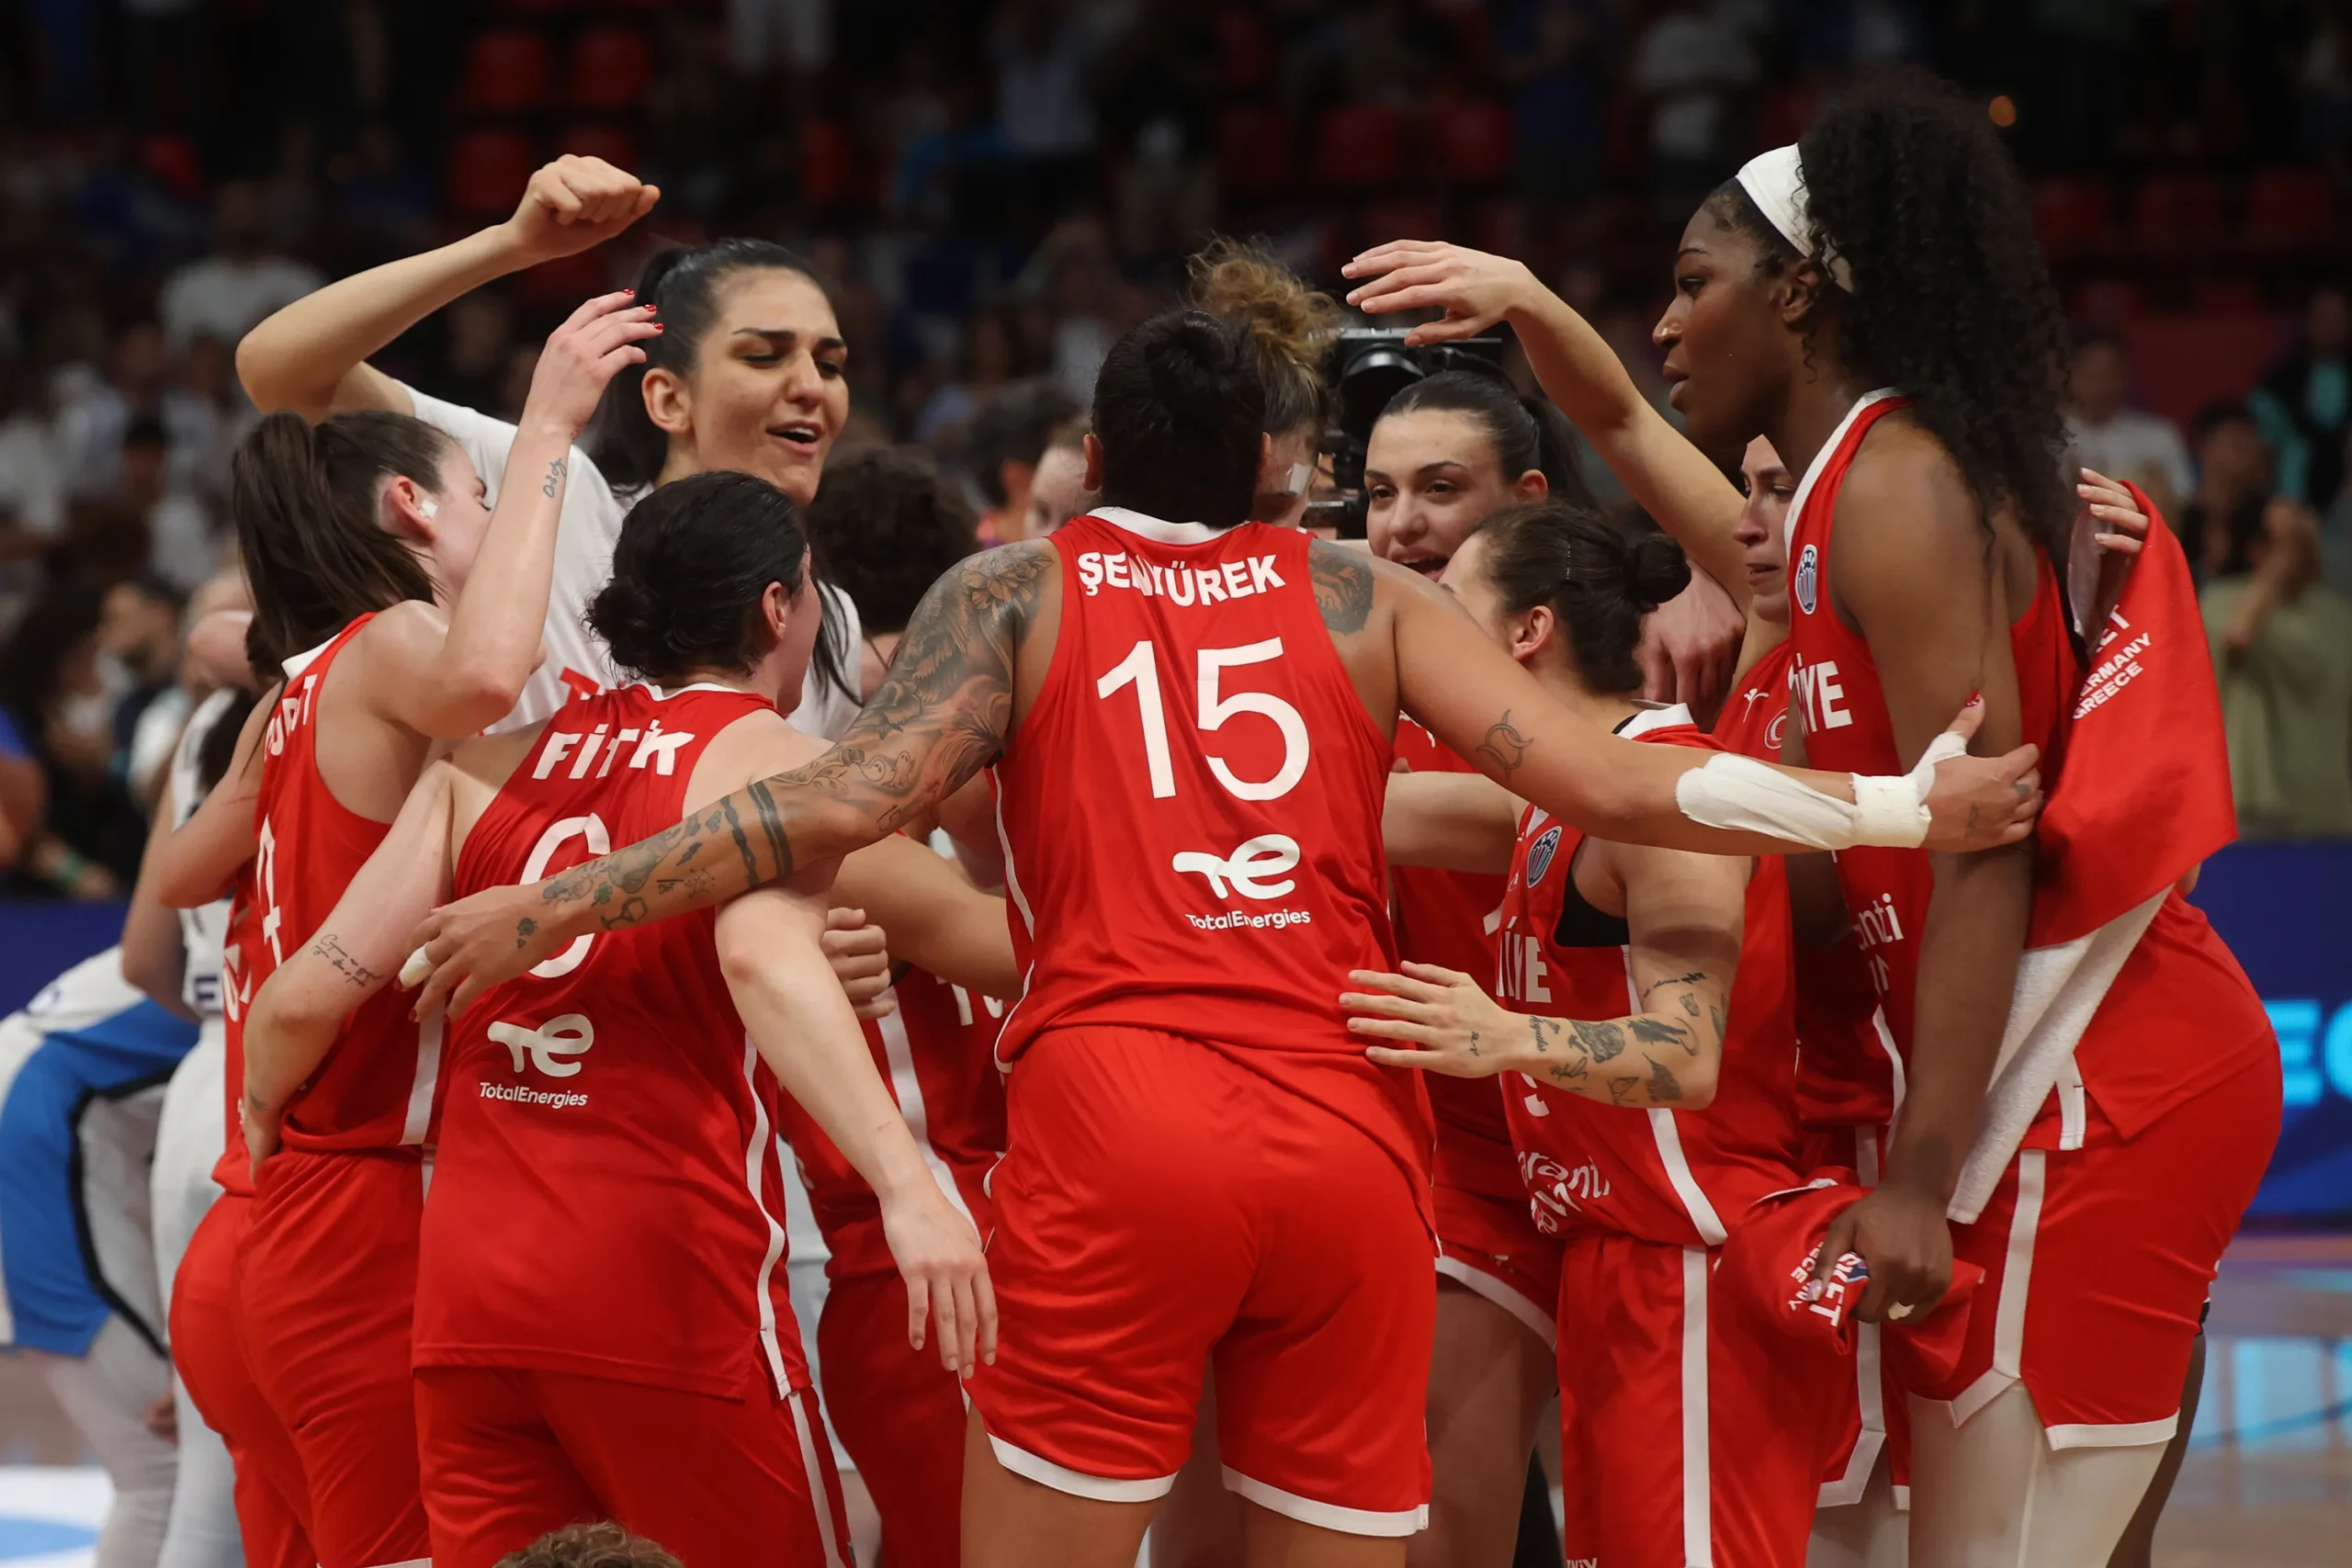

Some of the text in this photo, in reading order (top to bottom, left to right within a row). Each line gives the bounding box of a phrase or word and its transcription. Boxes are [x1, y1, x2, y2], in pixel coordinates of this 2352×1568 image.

[1077, 551, 1286, 607] ŞENYÜREK
[2078, 632, 2152, 701] ERMANY
[1096, 636, 1311, 802] 15
[1184, 908, 1311, 931] TotalEnergies
[479, 1081, 589, 1110] TotalEnergies
